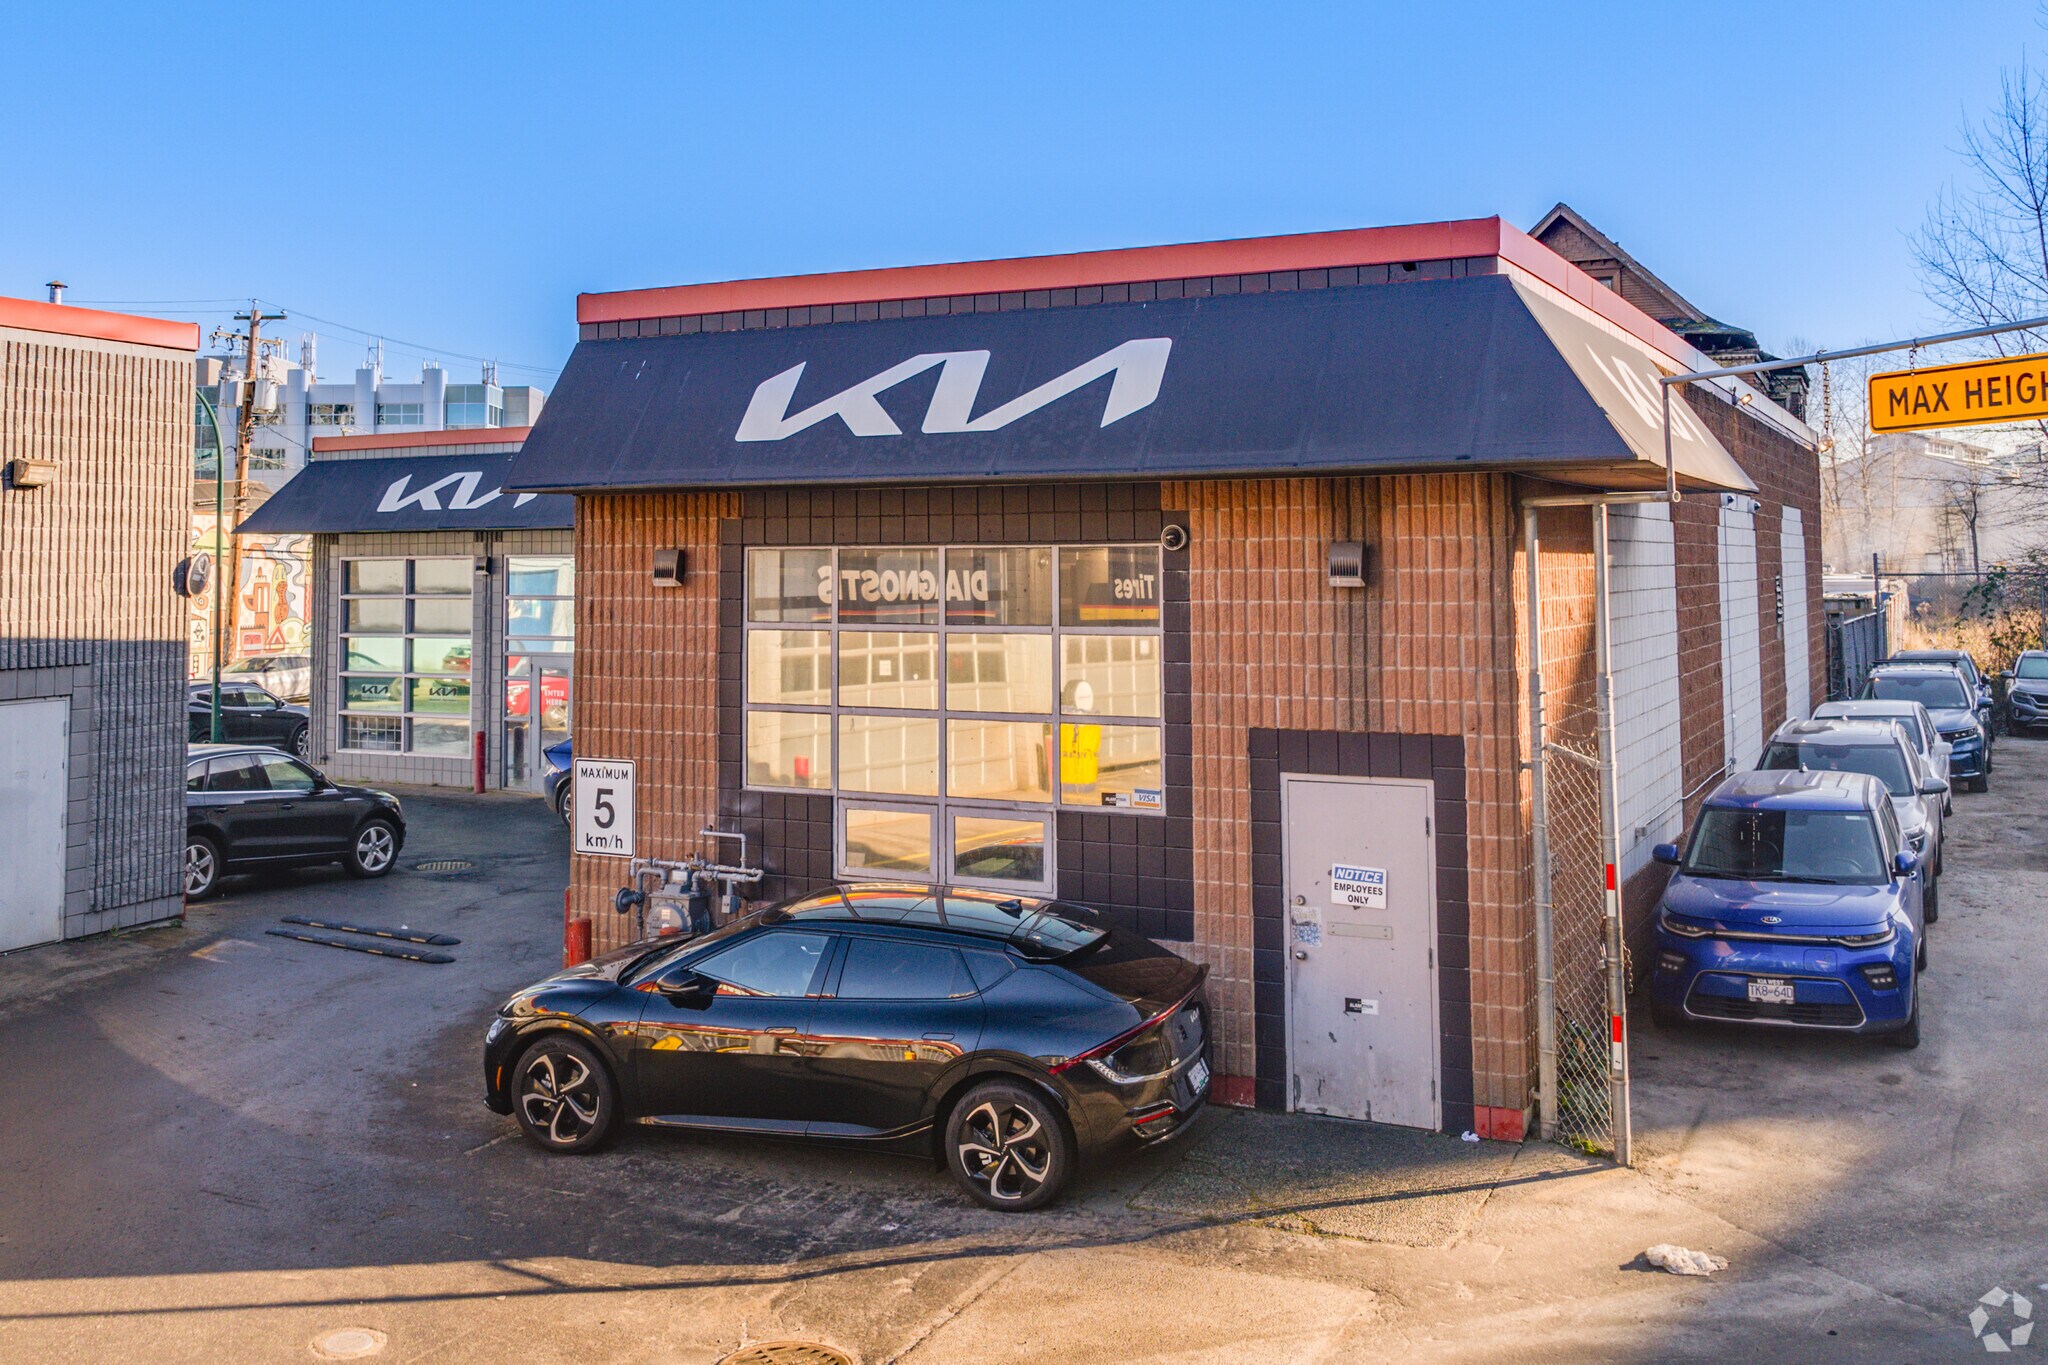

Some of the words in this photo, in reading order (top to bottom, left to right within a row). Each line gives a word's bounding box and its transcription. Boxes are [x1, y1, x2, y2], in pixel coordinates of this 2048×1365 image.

[735, 337, 1172, 442] KIA
[1889, 382, 1950, 417] MAX
[546, 698, 563, 706] HERE
[580, 767, 629, 780] MAXIMUM
[1139, 795, 1156, 803] VISA
[594, 788, 615, 829] 5
[585, 833, 623, 849] km/h
[1336, 868, 1382, 883] NOTICE
[1334, 882, 1383, 896] EMPLOYEES
[1347, 894, 1369, 905] ONLY
